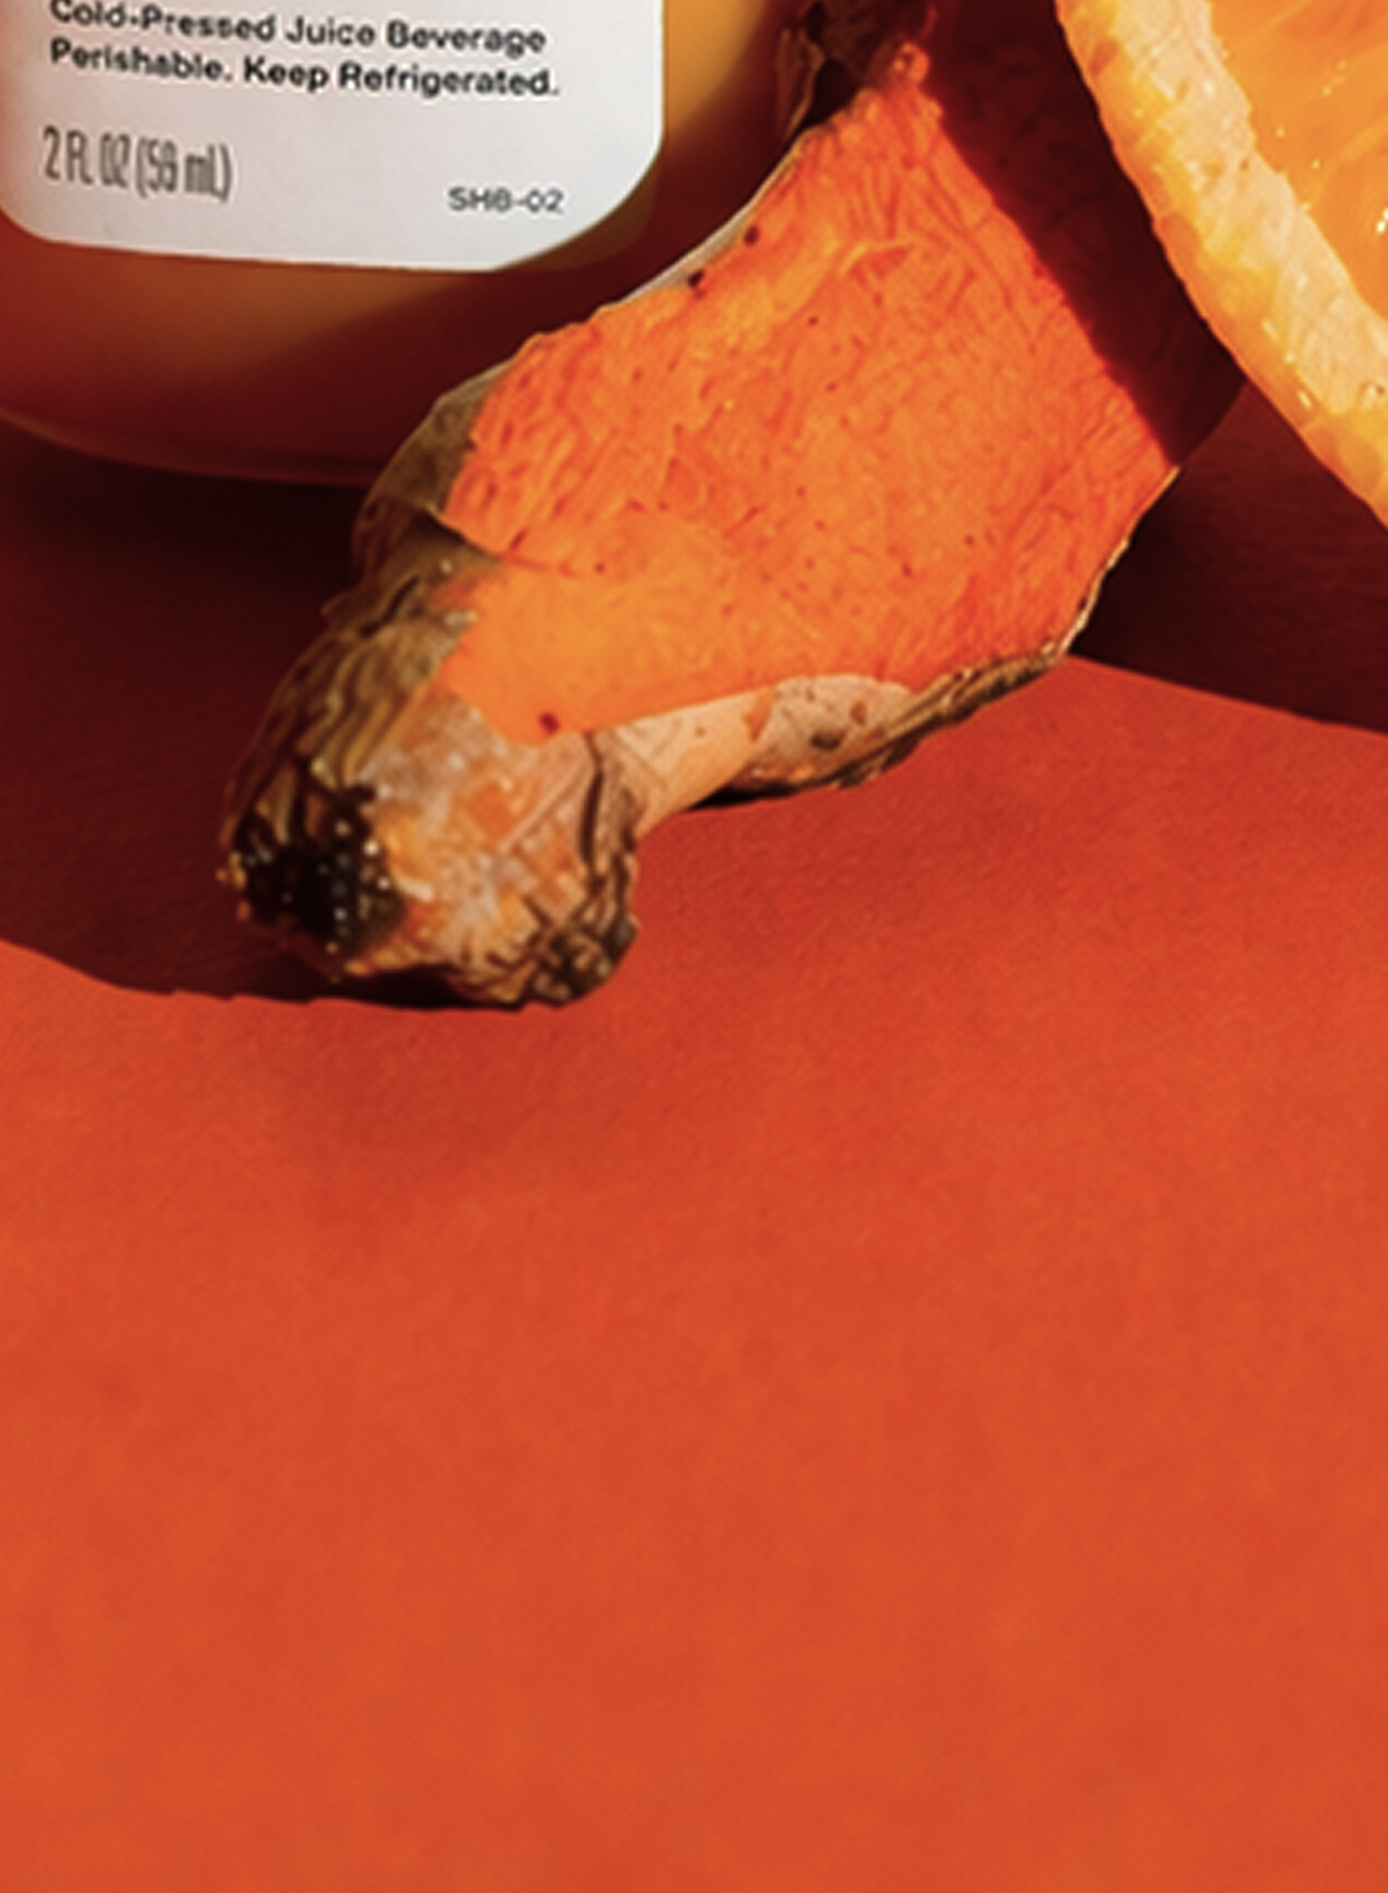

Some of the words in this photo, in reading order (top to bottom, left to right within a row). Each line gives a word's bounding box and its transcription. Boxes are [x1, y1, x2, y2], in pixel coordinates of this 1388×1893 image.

[284, 15, 377, 49] Juice
[384, 18, 549, 61] Beverage
[49, 36, 235, 83] Perishable.
[242, 52, 331, 94] Keep
[335, 58, 561, 101] Refrigerated.
[41, 123, 61, 182] 2
